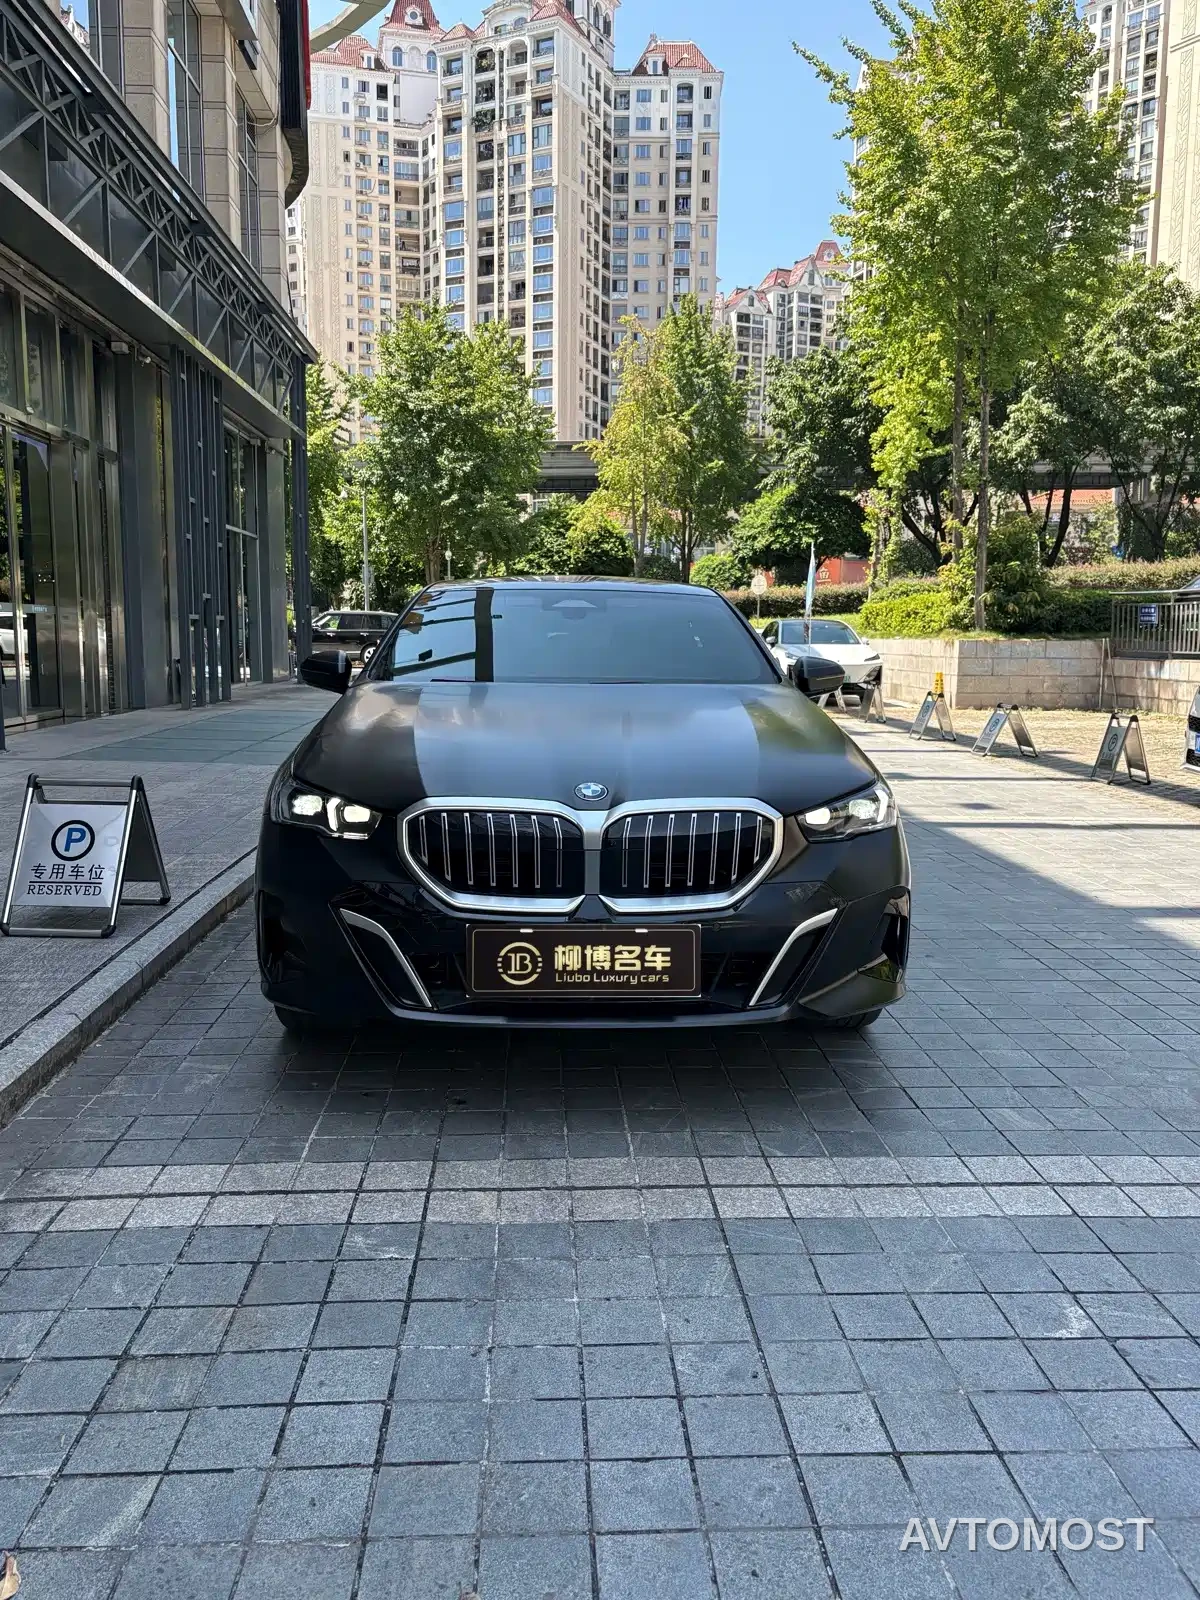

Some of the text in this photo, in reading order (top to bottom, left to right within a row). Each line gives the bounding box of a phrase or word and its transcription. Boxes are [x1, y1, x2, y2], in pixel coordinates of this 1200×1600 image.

[64, 827, 87, 852] P
[30, 863, 106, 881] 专用车位
[26, 884, 103, 896] RESERVED
[554, 944, 672, 971] 柳博名车
[555, 972, 670, 985] Liubo Luxury cars
